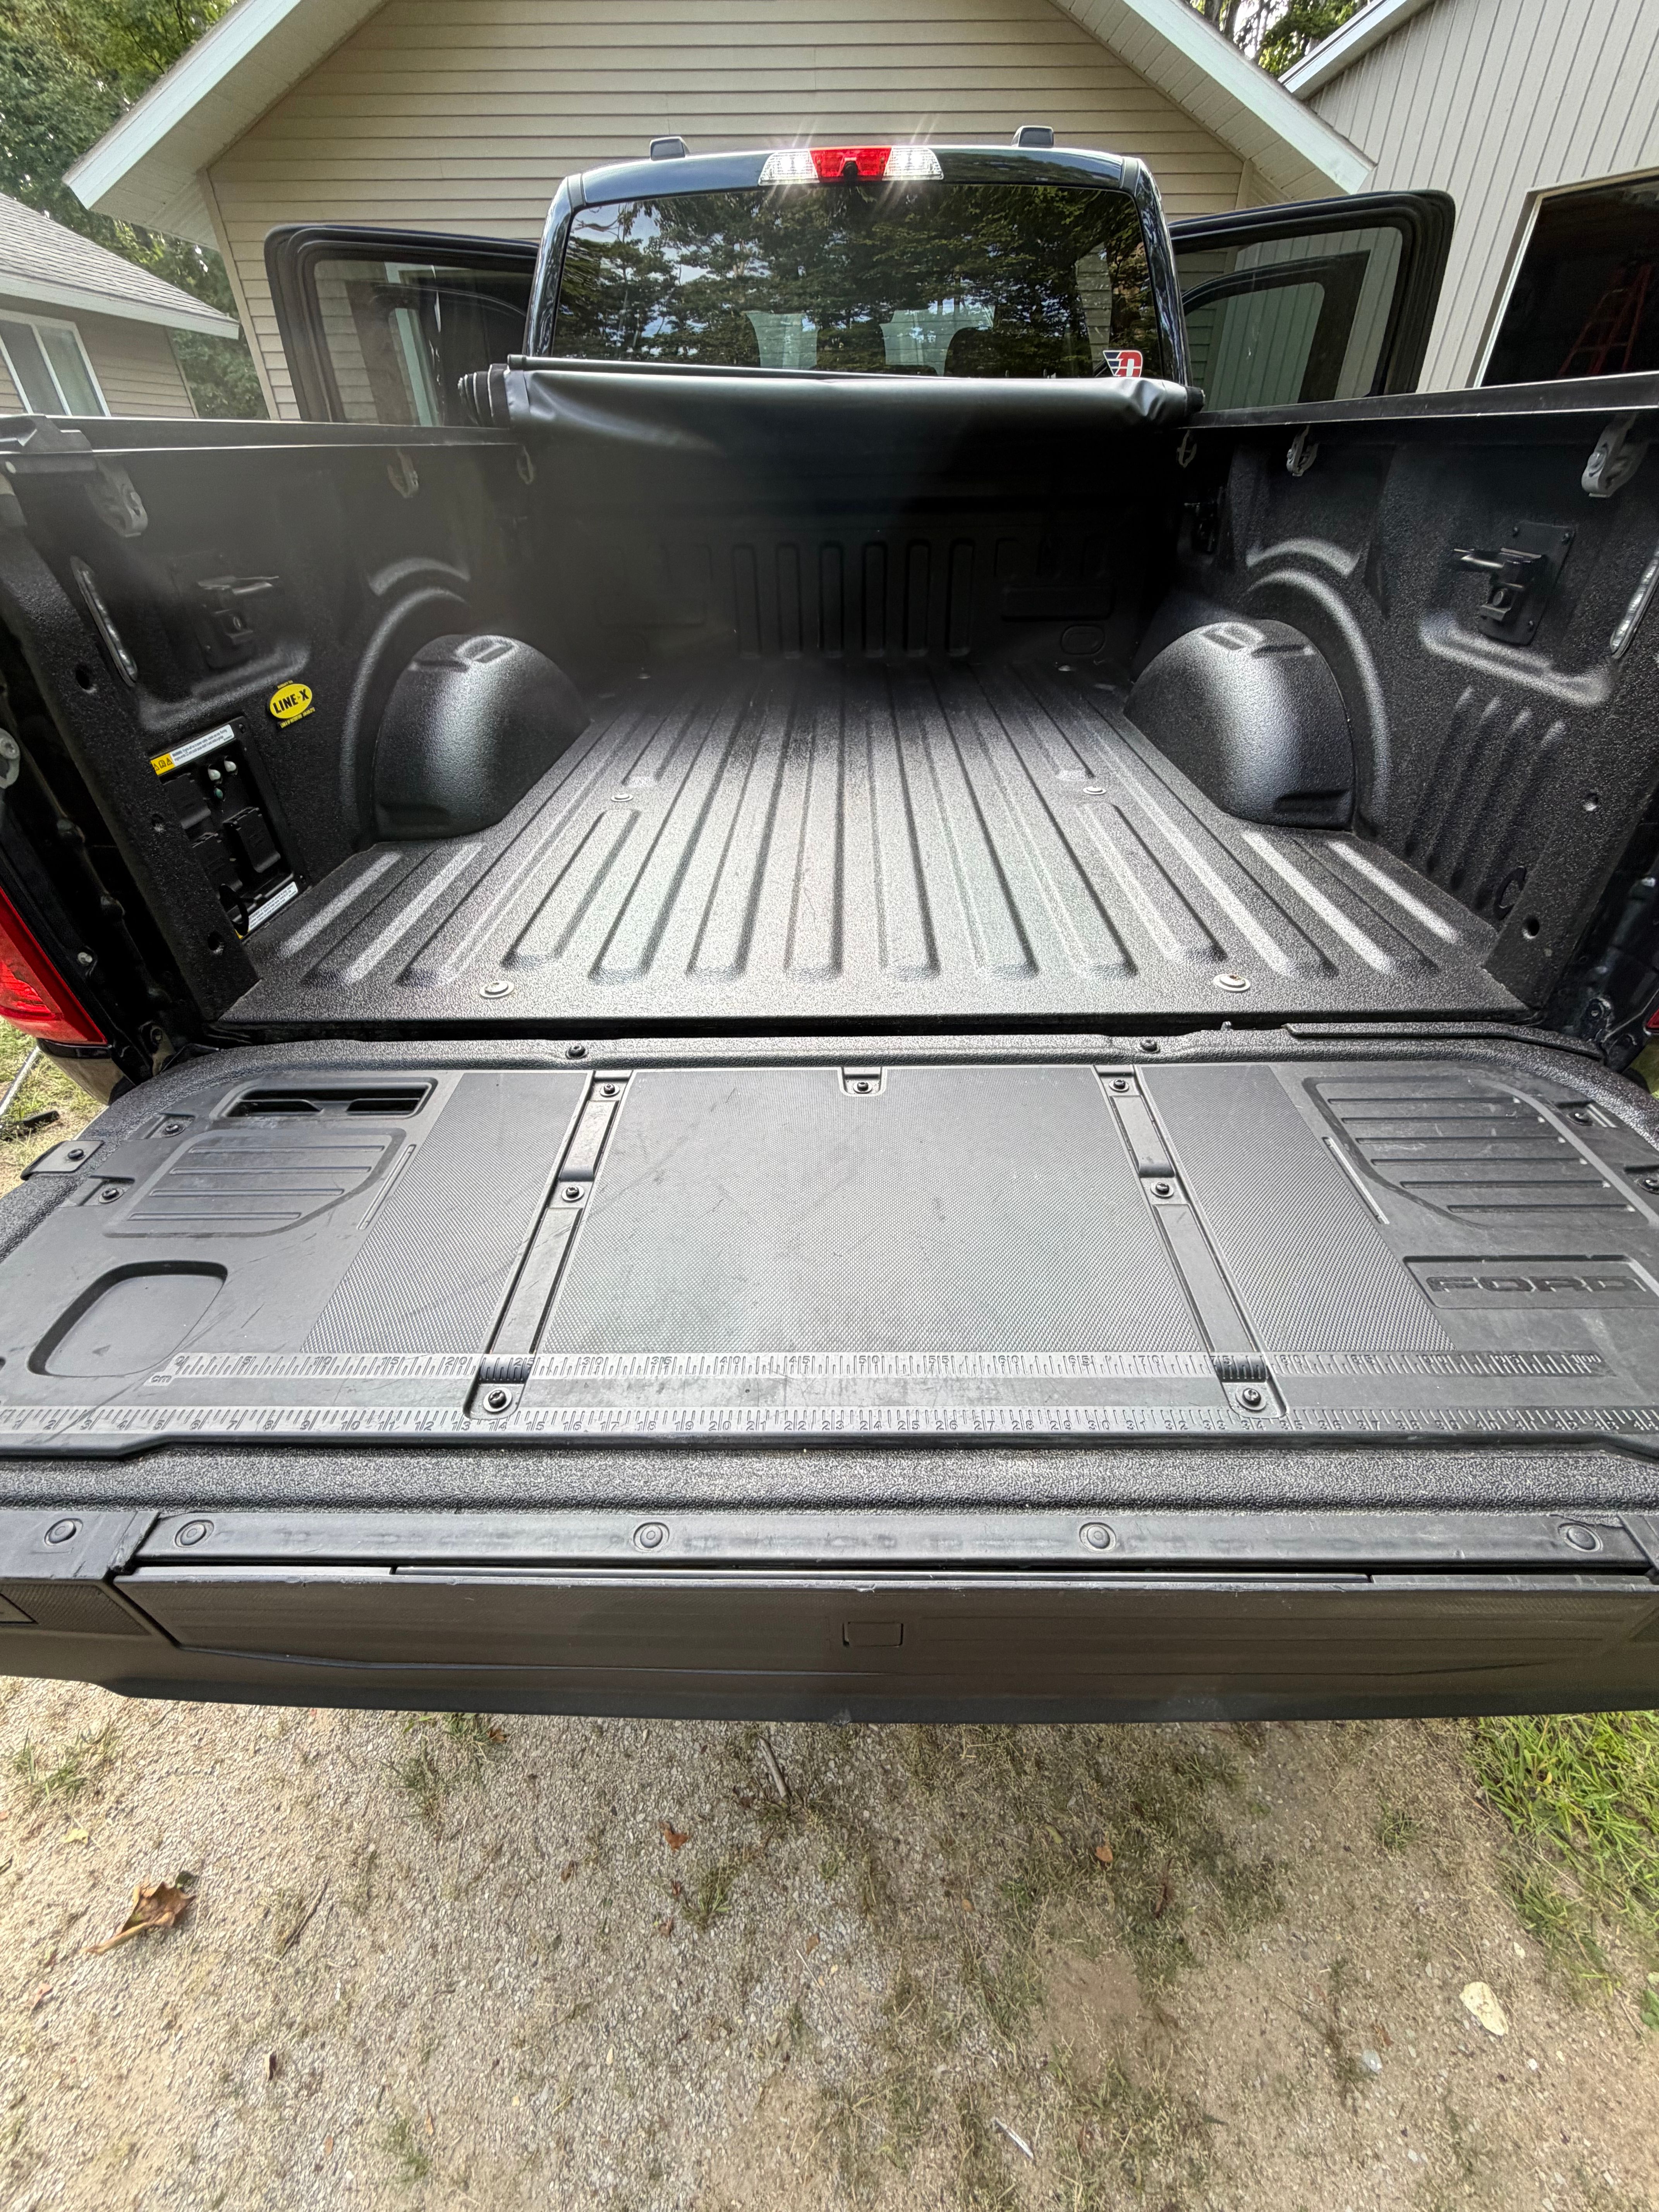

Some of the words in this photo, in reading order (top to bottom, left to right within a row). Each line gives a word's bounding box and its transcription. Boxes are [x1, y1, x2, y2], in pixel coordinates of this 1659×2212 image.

[1426, 1276, 1646, 1293] FORD
[242, 1356, 252, 1365] 5
[313, 1357, 332, 1365] 10
[381, 1357, 400, 1365] 15
[446, 1357, 467, 1365] 20
[582, 1357, 604, 1365] 30
[651, 1357, 672, 1365] 35
[720, 1356, 741, 1364] 40
[789, 1356, 810, 1364] 45
[859, 1355, 880, 1364] 50
[929, 1355, 950, 1364] 55
[998, 1355, 1019, 1364] 60
[1068, 1355, 1090, 1364] 65
[1138, 1355, 1160, 1364] 70
[1210, 1356, 1233, 1365] 75
[43, 1420, 57, 1430] 2
[80, 1420, 92, 1430] 3
[117, 1420, 128, 1430] 4
[153, 1420, 165, 1430] 5
[190, 1420, 201, 1431] 6
[226, 1420, 238, 1430] 7
[263, 1420, 273, 1431] 8
[300, 1420, 310, 1430] 9
[341, 1421, 361, 1431] 10
[378, 1421, 395, 1431] 11
[415, 1421, 434, 1431] 12
[452, 1422, 471, 1431] 13
[489, 1422, 507, 1431] 14
[526, 1422, 545, 1431] 15
[563, 1421, 582, 1431] 16
[600, 1421, 620, 1431] 17
[637, 1421, 656, 1431] 18
[675, 1421, 694, 1431] 19
[708, 1421, 732, 1431] 20
[746, 1421, 766, 1431] 21
[784, 1420, 806, 1431] 22
[822, 1420, 844, 1431] 23
[860, 1420, 882, 1431] 24
[898, 1420, 920, 1431] 25
[936, 1420, 958, 1431] 26
[974, 1420, 995, 1431] 27
[1012, 1420, 1034, 1430] 28
[1050, 1420, 1072, 1431] 29
[1088, 1420, 1111, 1431] 30
[1126, 1420, 1146, 1431] 31
[1164, 1420, 1188, 1430] 32
[1202, 1420, 1227, 1430] 33
[1241, 1420, 1267, 1431] 34
